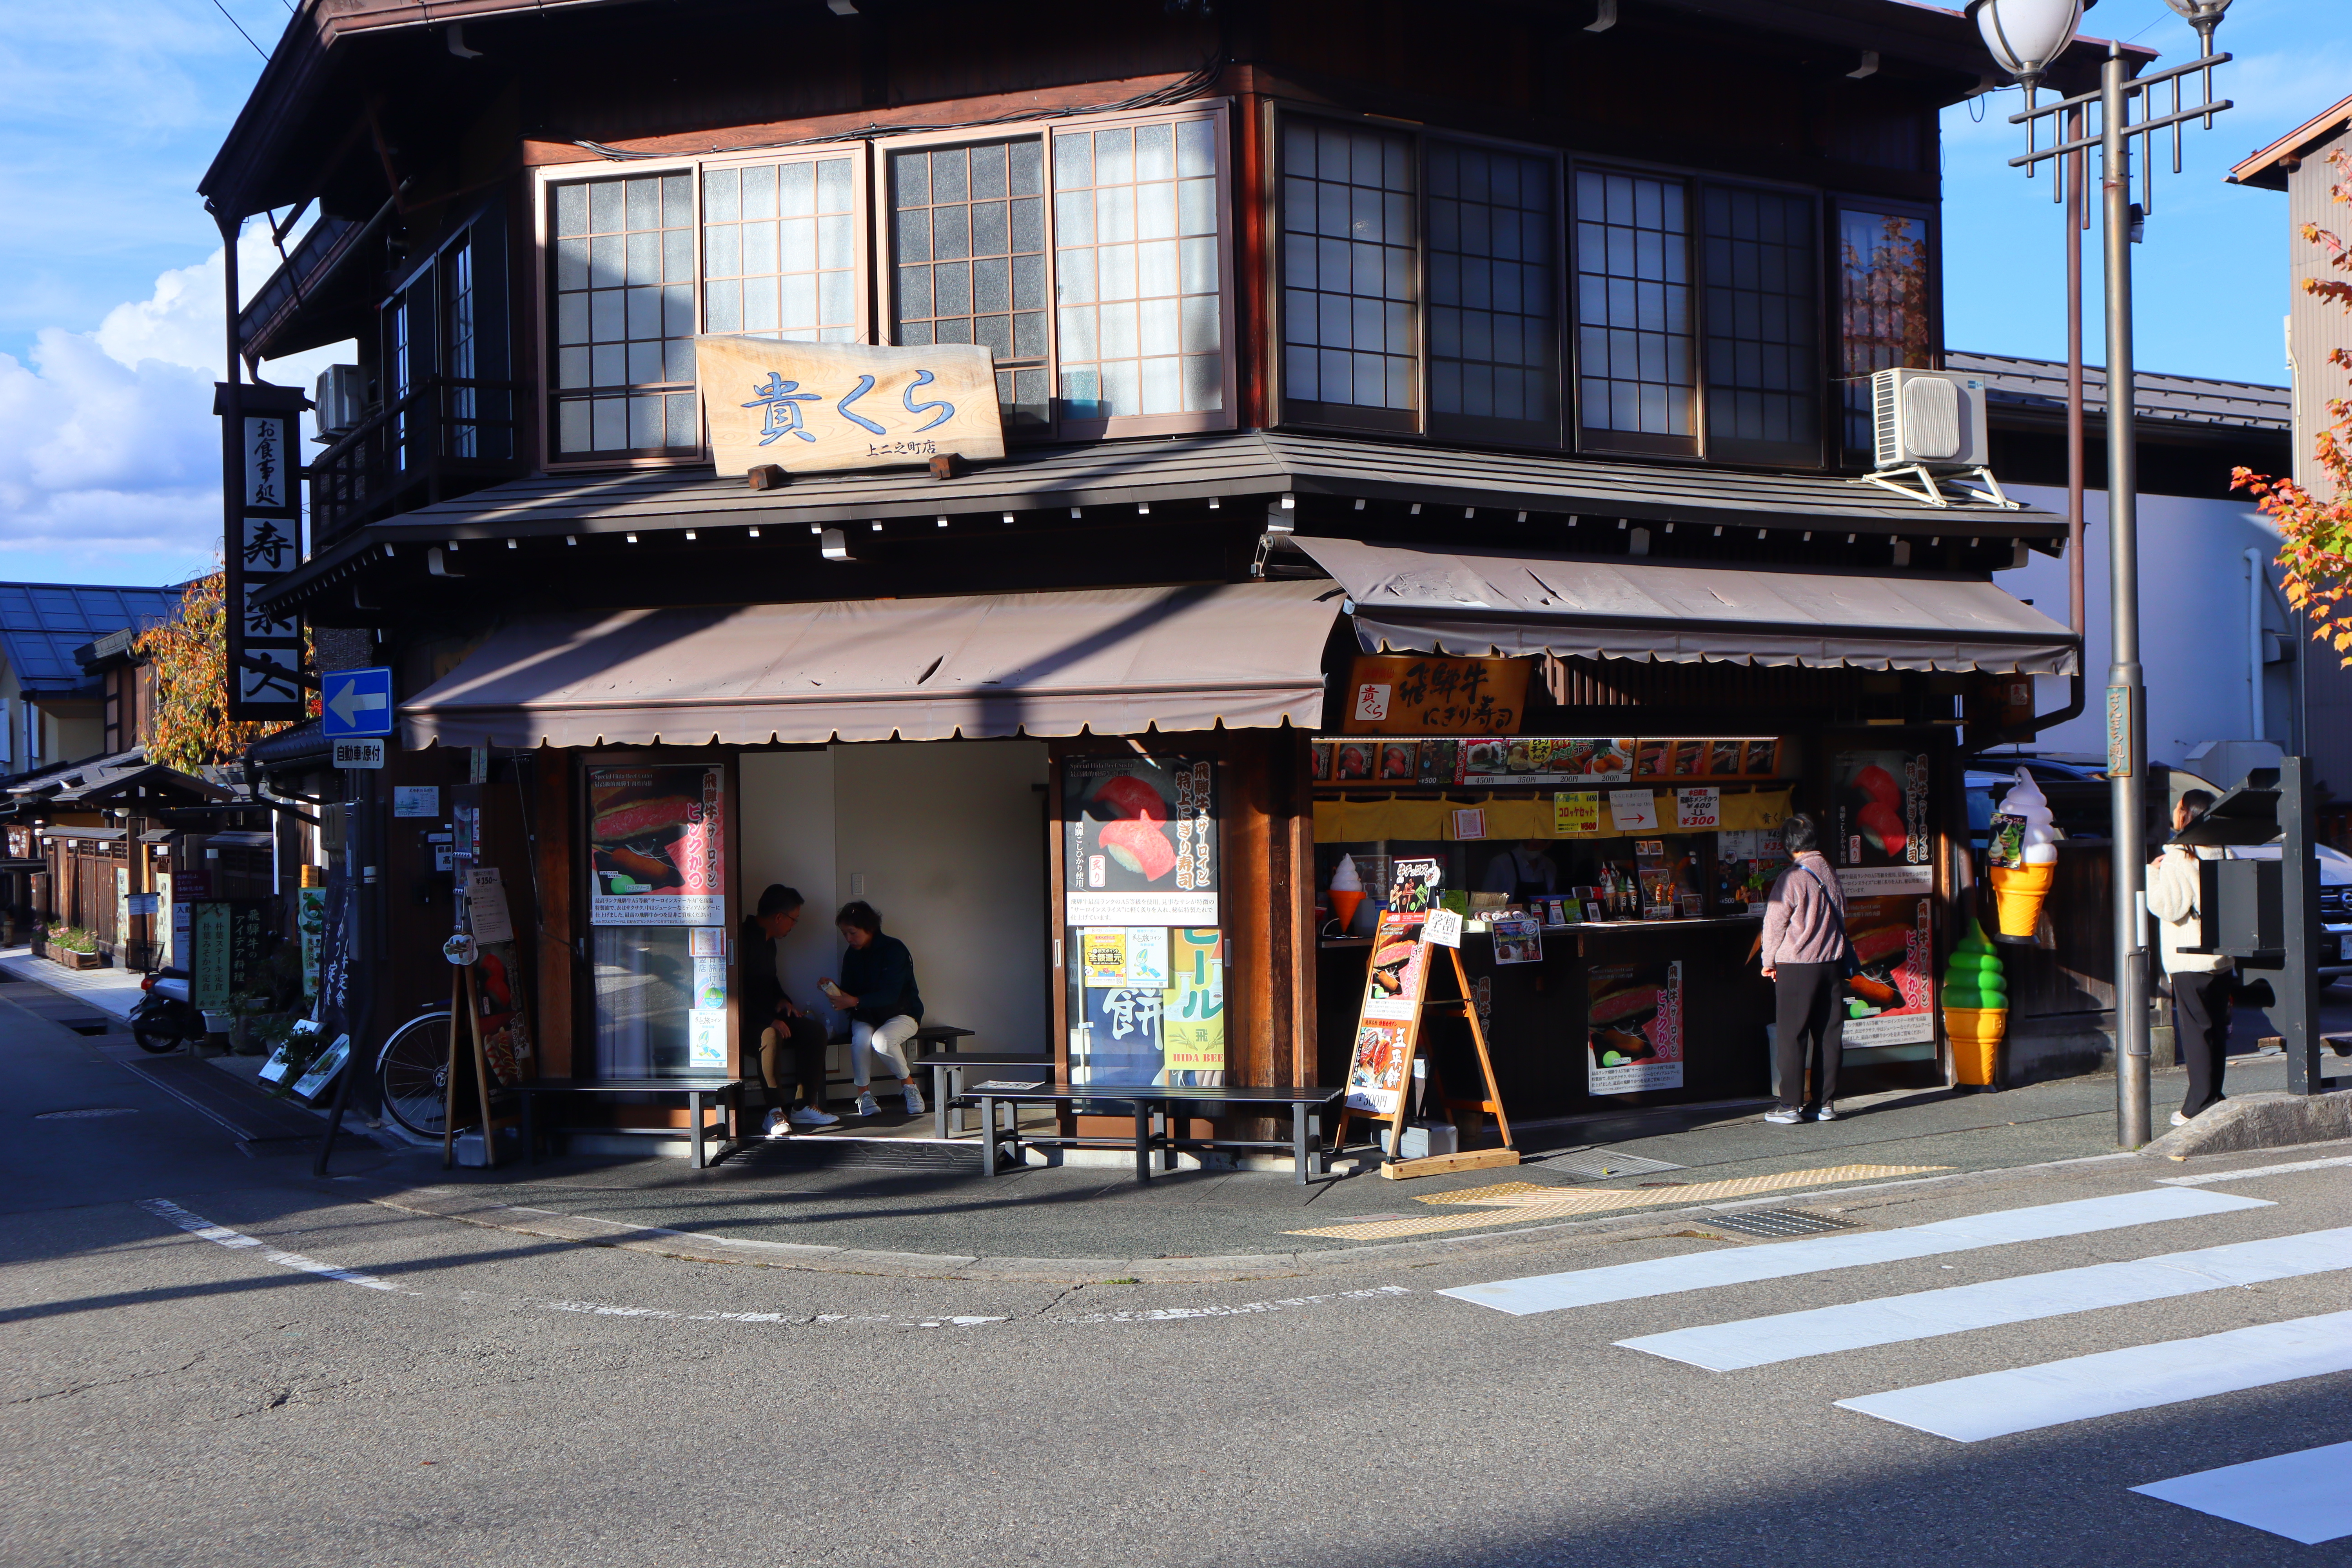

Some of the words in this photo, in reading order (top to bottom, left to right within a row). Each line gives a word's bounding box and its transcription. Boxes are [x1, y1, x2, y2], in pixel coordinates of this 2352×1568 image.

[740, 370, 955, 446] 貴くら
[254, 419, 279, 505] お食事処
[866, 439, 936, 457] 上二之町店
[1399, 662, 1488, 707] 飛騨牛
[1423, 695, 1513, 730] にぎり寿司
[1531, 746, 1550, 754] チーズ
[1176, 773, 1193, 888] 特上にぎり寿司
[1559, 806, 1595, 817] コロッケセット
[1682, 816, 1715, 825] ¥300
[1907, 762, 1918, 863] 特上にぎり寿司
[1992, 814, 2013, 824] モコモコ
[688, 803, 703, 888] ピンクかつ
[1075, 821, 1084, 887] 飛騨こしひかり使用
[1092, 859, 1102, 882] 炙り
[247, 909, 260, 958] 飛騨牛の
[1431, 913, 1456, 932] 学割
[201, 922, 211, 991] 朴葉みそかつ定食
[214, 922, 224, 991] 朴葉ステーキ定食
[234, 915, 246, 982] アイデア料理
[1089, 953, 1122, 962] 全額還元
[1907, 930, 1918, 1008] ピンクかつ
[1657, 989, 1668, 1057] ピンクかつ
[1173, 1053, 1200, 1062] HIDA
[1385, 1027, 1406, 1089] 五平餅
[1363, 1093, 1388, 1108] 300円
